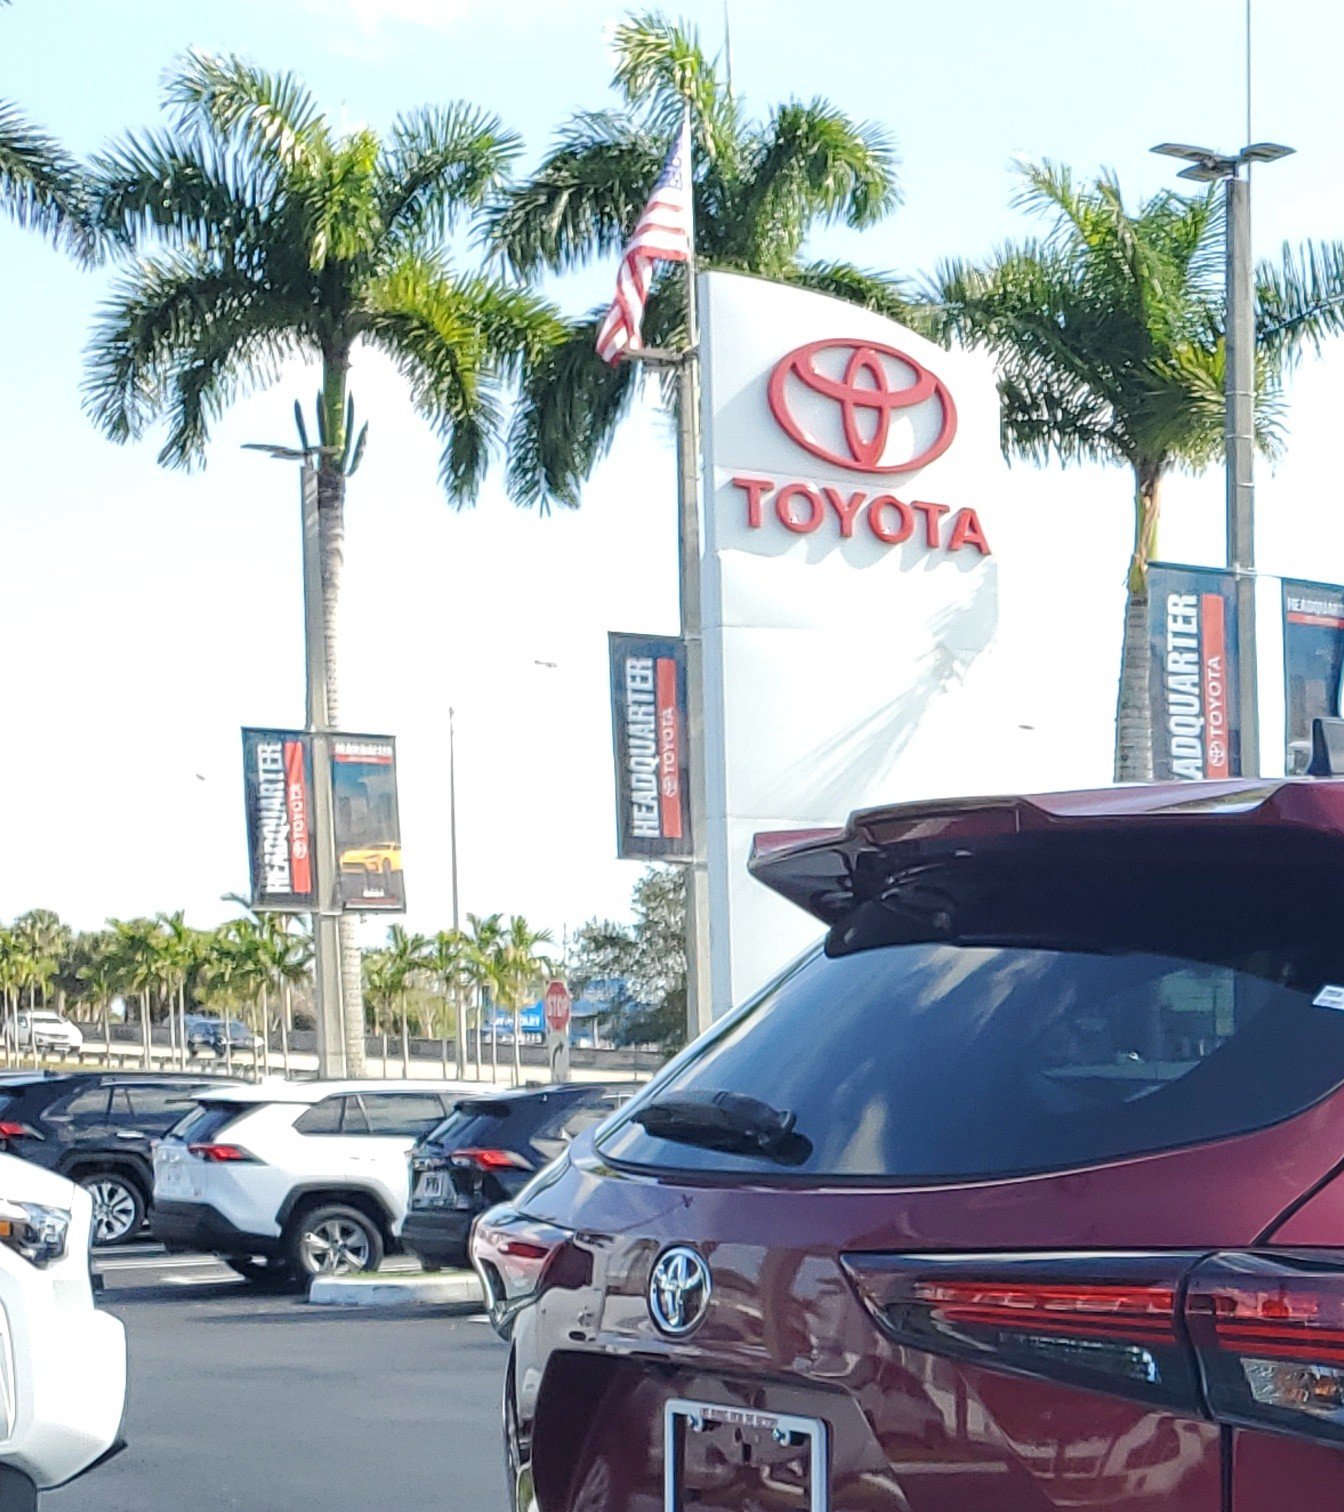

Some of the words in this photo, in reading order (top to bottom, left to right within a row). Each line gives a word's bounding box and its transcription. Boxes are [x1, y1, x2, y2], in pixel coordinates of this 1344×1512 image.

[732, 477, 992, 556] TOYOTA
[662, 706, 677, 774] TOYOTA
[1167, 594, 1205, 780] ADQUARTER
[1208, 656, 1224, 737] TOYOTA
[625, 657, 661, 837] HEADQUARTER
[257, 742, 291, 893] HEADQUARTER
